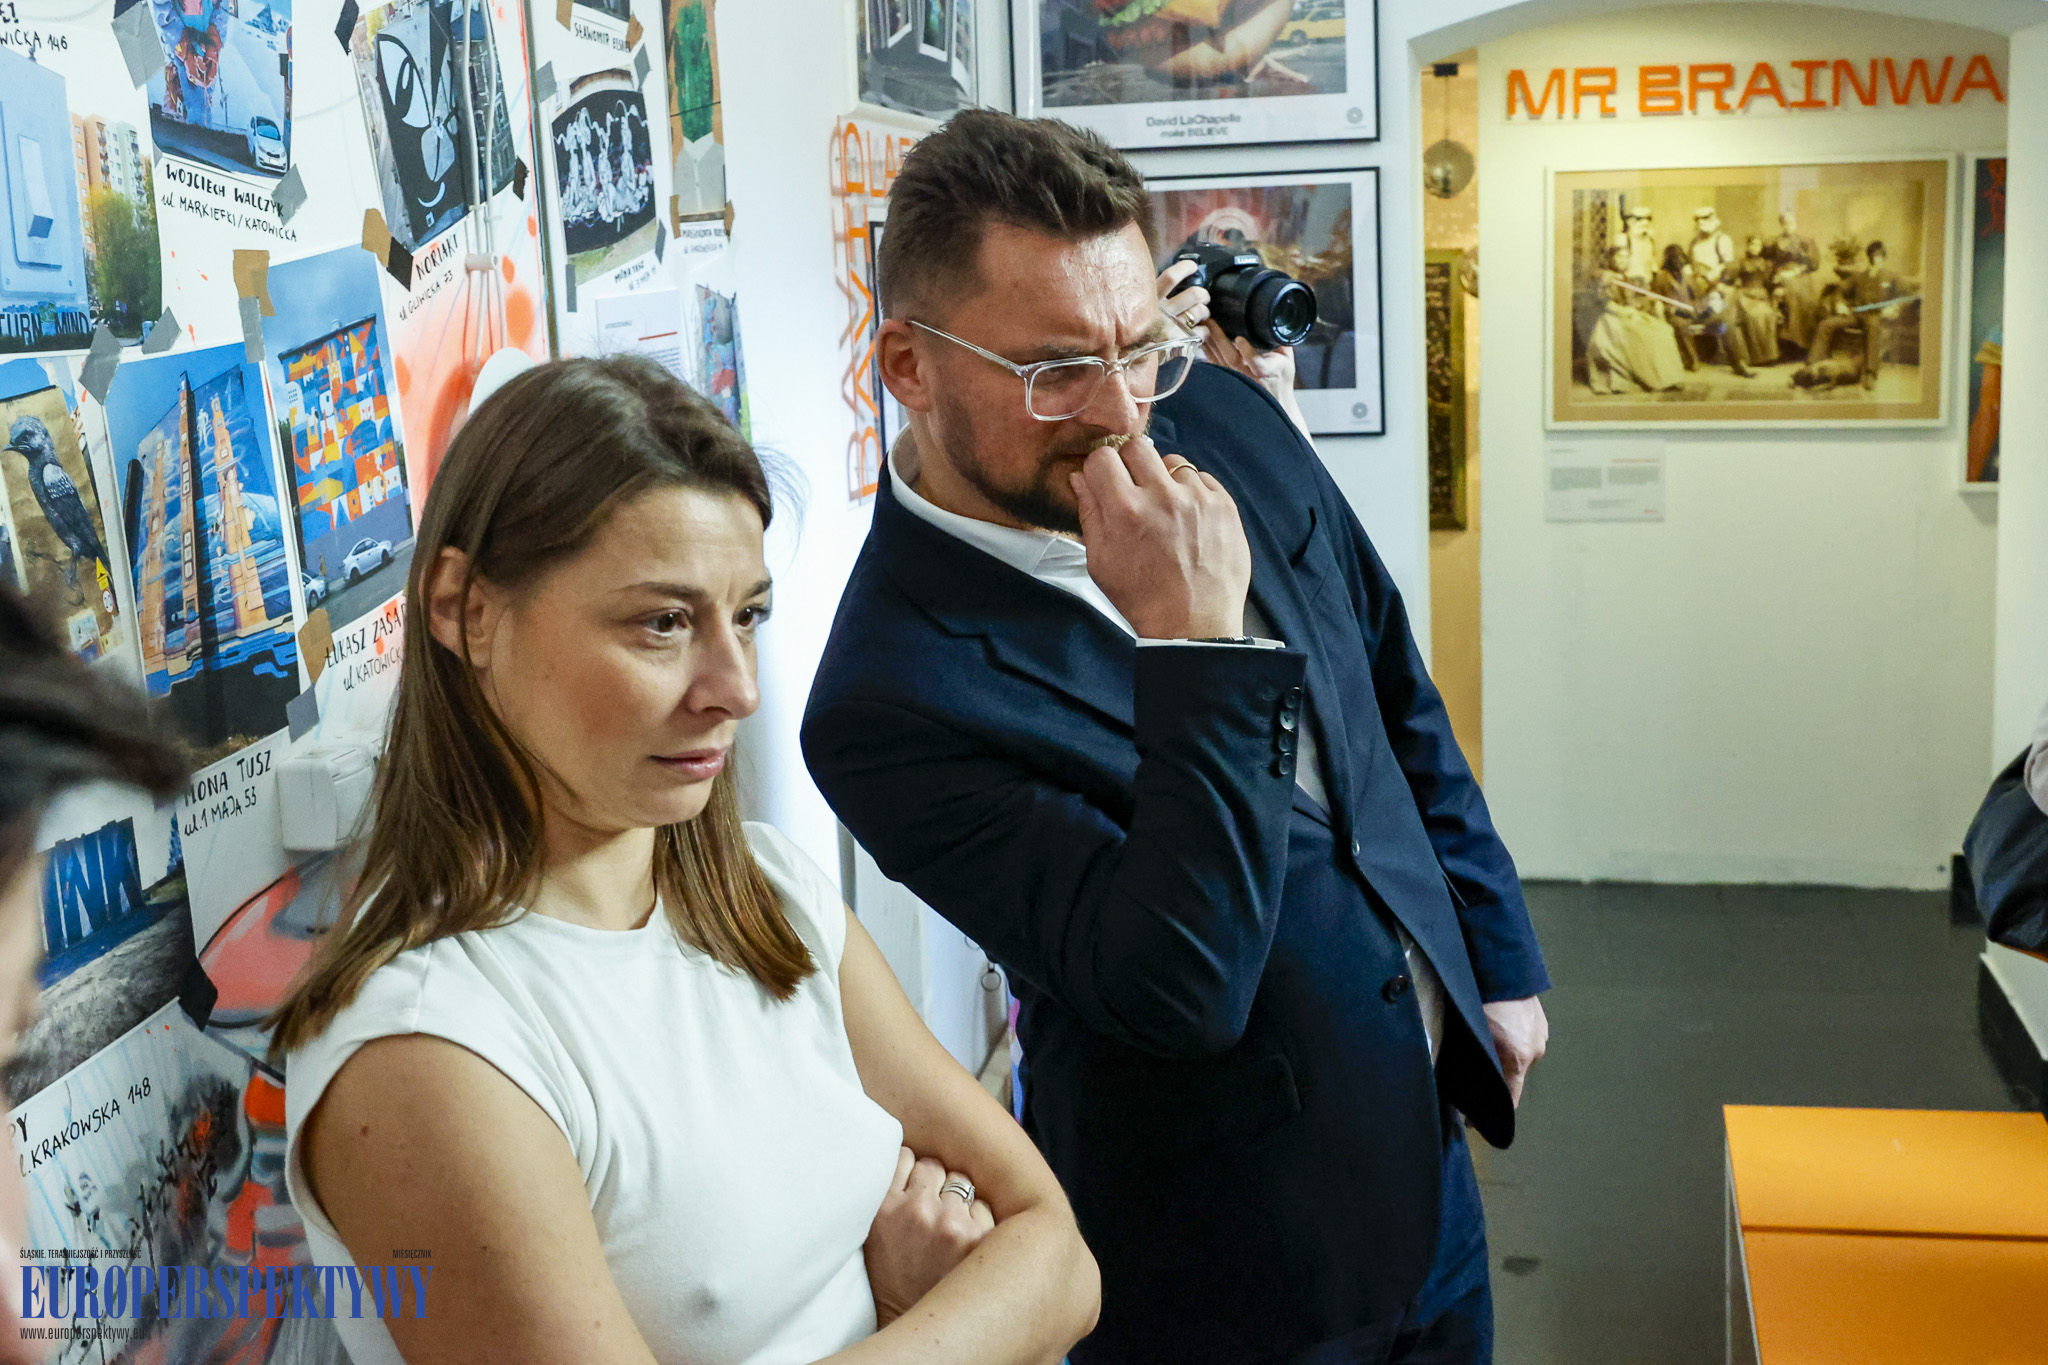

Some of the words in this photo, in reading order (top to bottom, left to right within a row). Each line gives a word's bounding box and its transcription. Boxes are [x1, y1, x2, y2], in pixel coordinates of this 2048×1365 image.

[48, 34, 68, 51] 146
[1506, 67, 1617, 116] MR
[1638, 54, 2007, 115] BRAINWA
[1146, 116, 1177, 126] David
[1180, 113, 1242, 126] LaChapelle
[1187, 126, 1228, 137] BELIEVE
[165, 163, 226, 198] WOJCIECH
[234, 187, 284, 218] WALCZYK
[415, 233, 459, 280] NORIAKI
[1237, 257, 1258, 265] LUMIX
[324, 627, 366, 669] ŁUKASZ
[183, 771, 229, 808] MONA
[236, 749, 272, 783] TUSZ
[211, 794, 243, 823] MAJA
[244, 785, 257, 808] 53
[31, 1098, 121, 1168] KRAKOWSKA
[128, 1076, 152, 1104] 148
